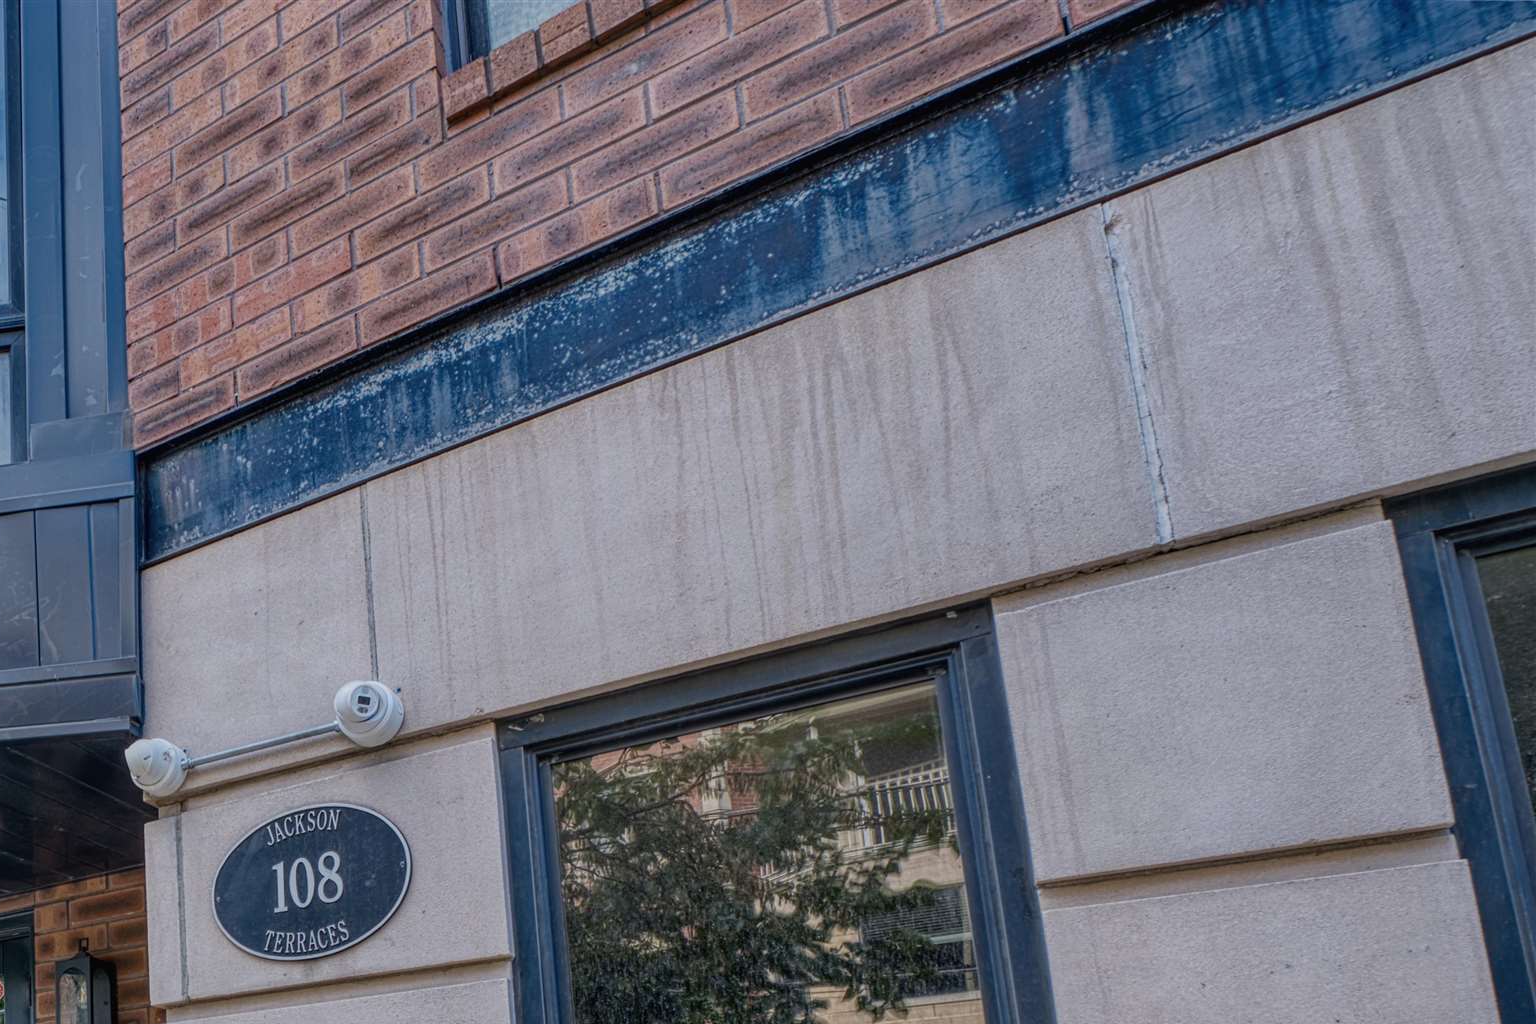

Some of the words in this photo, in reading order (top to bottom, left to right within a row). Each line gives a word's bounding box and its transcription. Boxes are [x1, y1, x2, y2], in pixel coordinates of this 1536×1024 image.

[266, 808, 341, 846] JACKSON
[271, 850, 344, 913] 108
[263, 919, 350, 954] TERRACES
